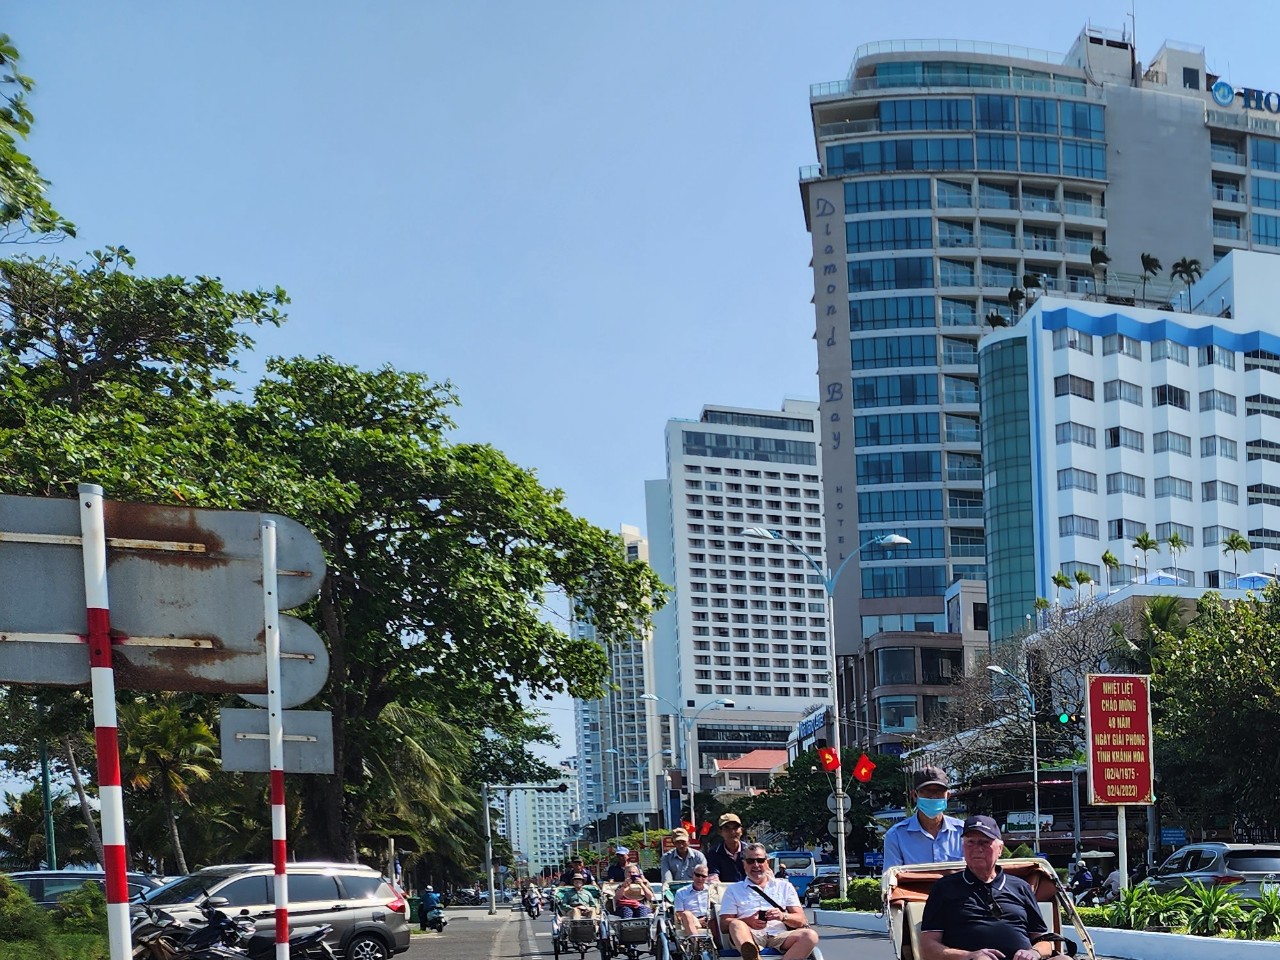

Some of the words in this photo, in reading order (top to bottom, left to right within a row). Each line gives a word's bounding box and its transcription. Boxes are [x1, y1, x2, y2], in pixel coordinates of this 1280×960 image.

[815, 197, 838, 348] Diamond
[825, 382, 844, 450] Bay
[835, 485, 846, 560] HOTEL
[1102, 679, 1121, 697] NHIỆT
[1121, 679, 1134, 697] LIỆT
[1101, 697, 1118, 712] CHÀO
[1118, 697, 1137, 712] MỪNG
[1108, 716, 1116, 729] 48
[1116, 714, 1131, 729] NĂM
[1094, 730, 1111, 746] NGÀY
[1111, 729, 1125, 746] GIẢI
[1125, 731, 1146, 746] PHÓNG
[1096, 746, 1111, 763] TỈNH
[1111, 747, 1132, 763] KHÁNH
[1132, 747, 1145, 763] HÒA
[1104, 767, 1136, 780] (02/4/1975
[1106, 784, 1138, 798] 02/4/2023)
